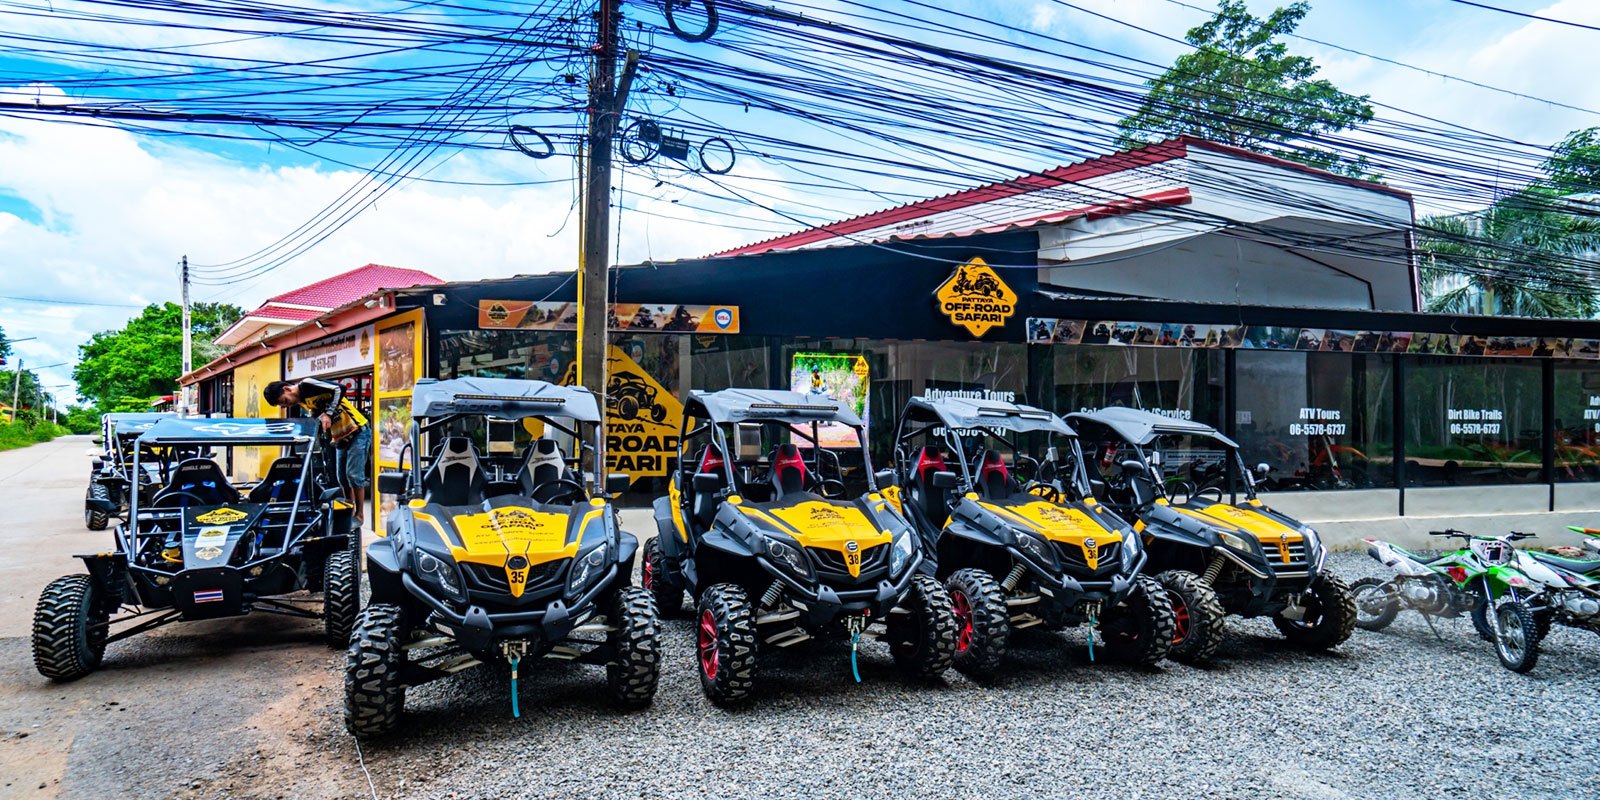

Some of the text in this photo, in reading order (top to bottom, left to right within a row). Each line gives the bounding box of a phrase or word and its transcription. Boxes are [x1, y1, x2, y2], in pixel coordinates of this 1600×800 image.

[945, 303, 1011, 313] OFF-ROAD
[955, 313, 1002, 322] SAFARI
[925, 388, 1015, 402] Adventure Tours
[1300, 408, 1341, 420] ATV Tours
[1448, 409, 1503, 420] Dirt Bike Trails
[606, 424, 645, 433] TAYA
[1290, 423, 1346, 436] 06-5578-6737
[1450, 423, 1501, 435] 06-5578-6737
[606, 436, 680, 452] ROAD
[606, 455, 662, 471] FARI
[848, 554, 860, 565] 38
[511, 571, 525, 584] 35
